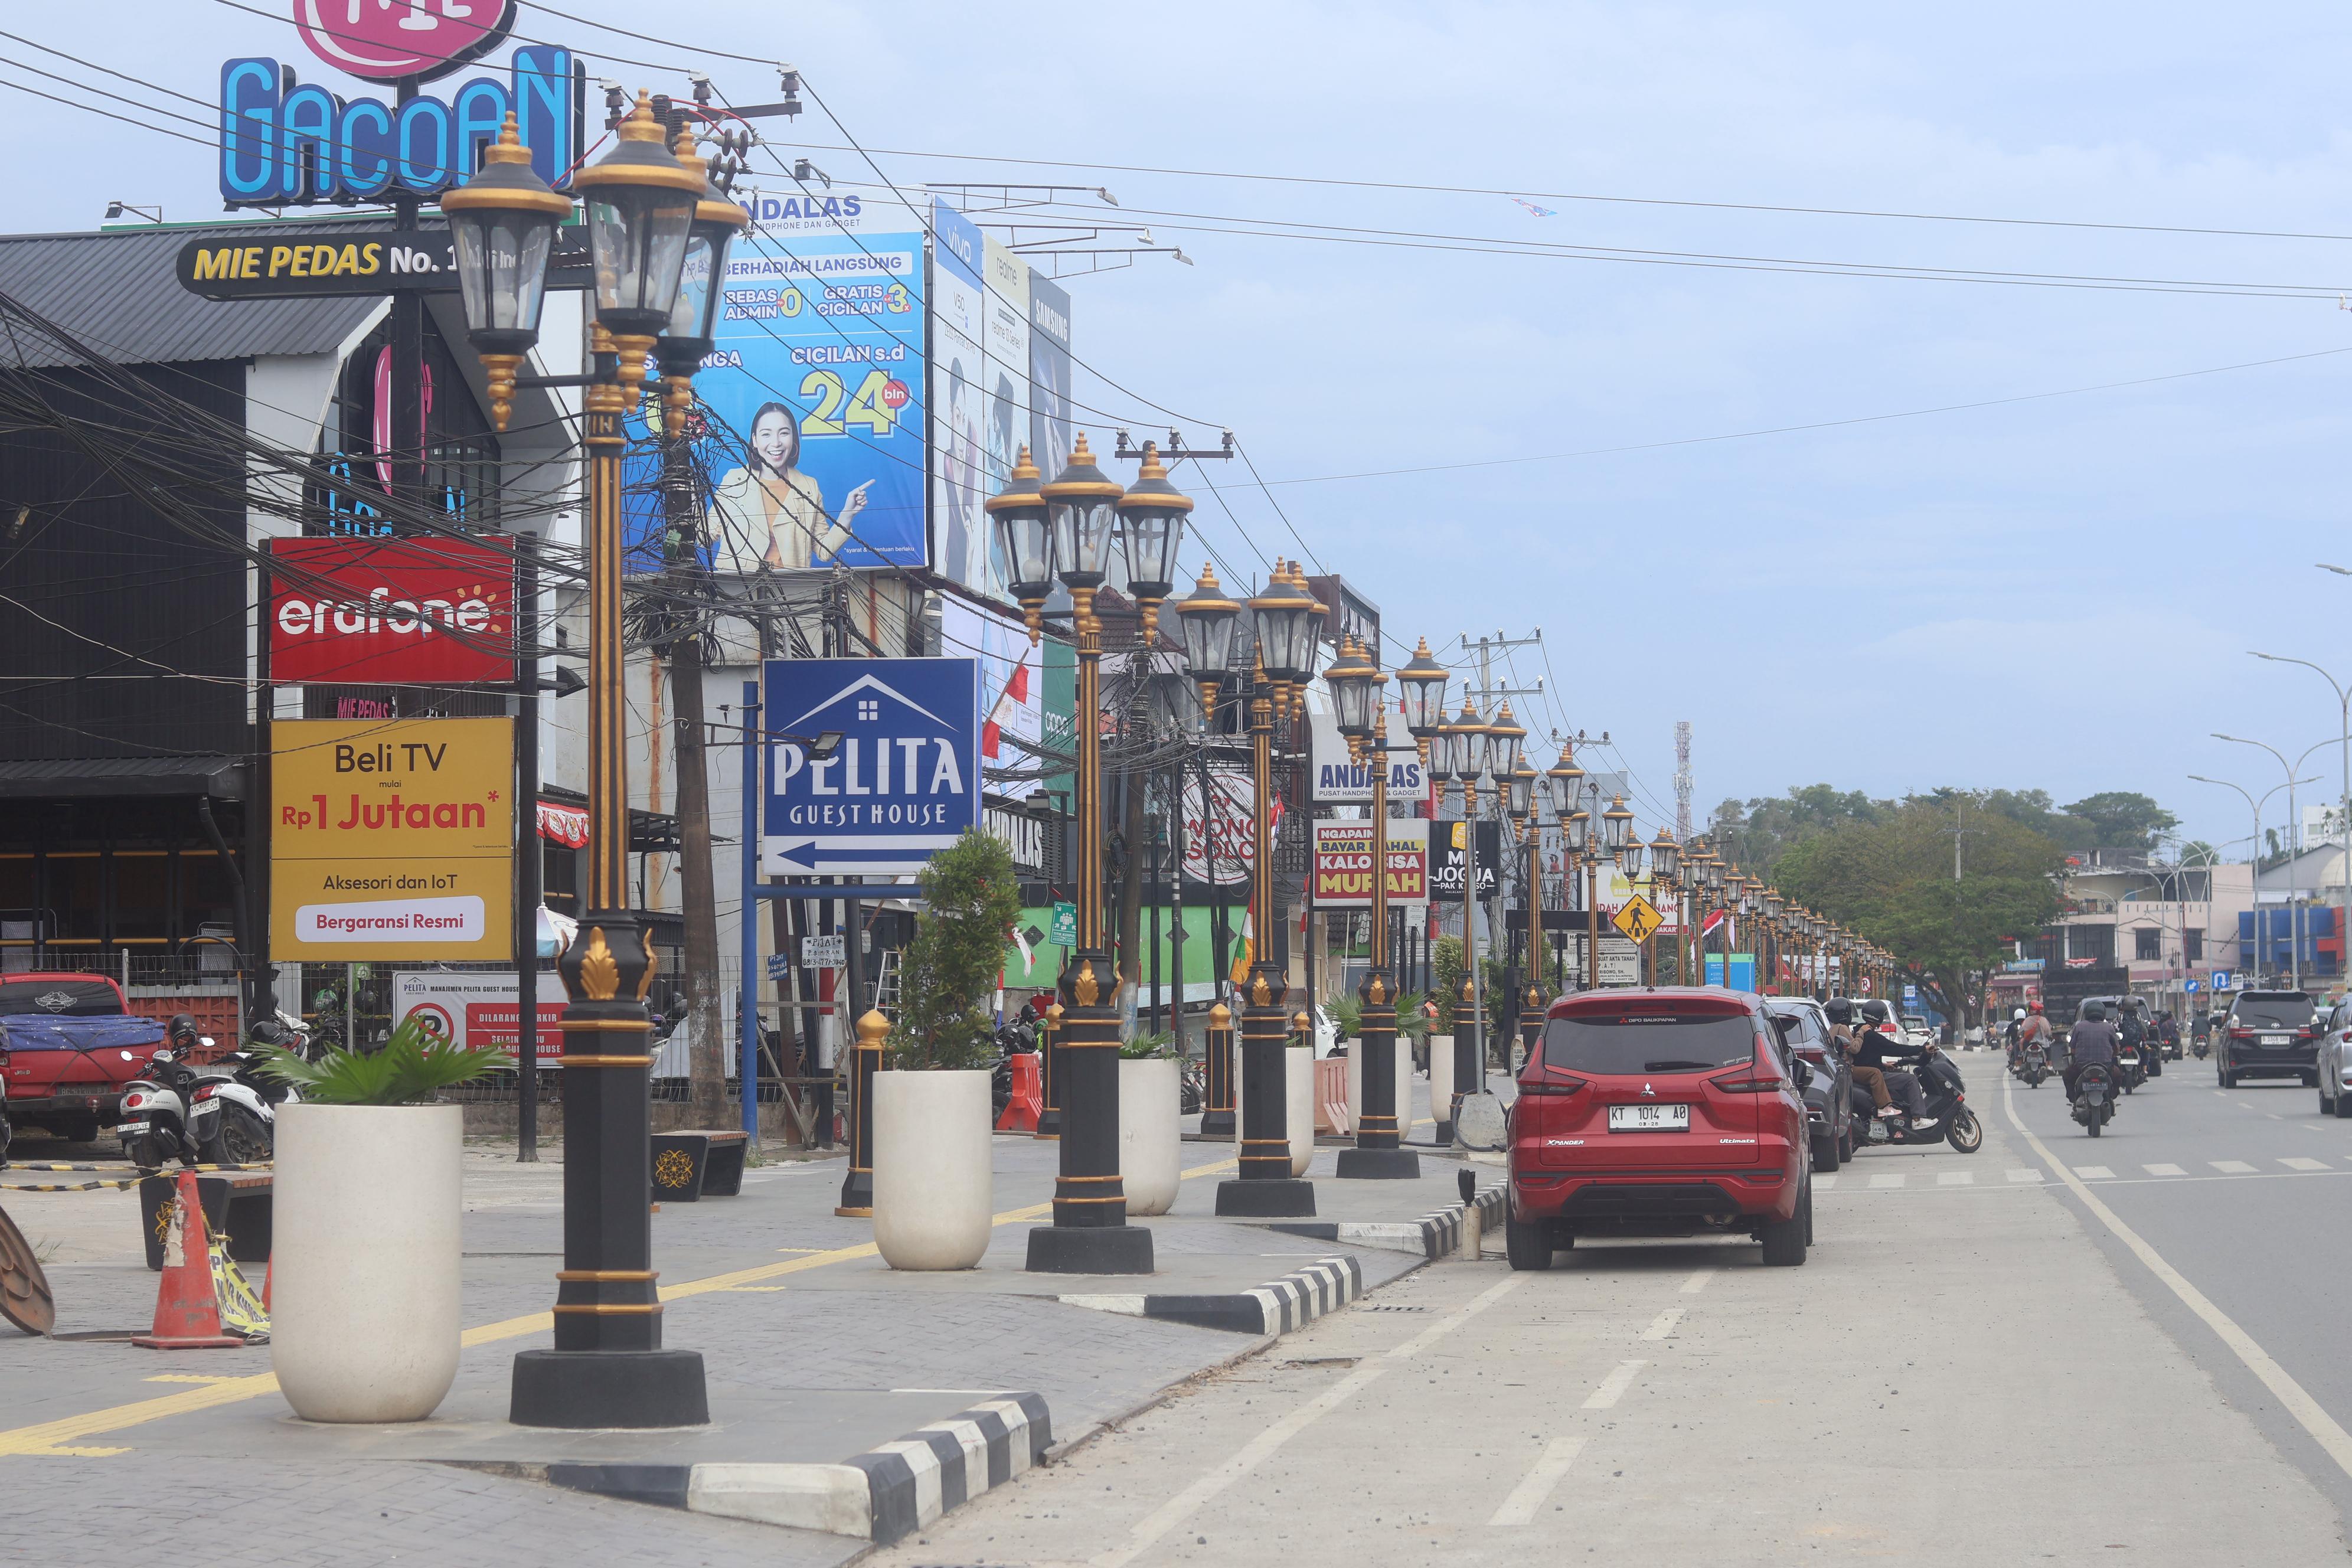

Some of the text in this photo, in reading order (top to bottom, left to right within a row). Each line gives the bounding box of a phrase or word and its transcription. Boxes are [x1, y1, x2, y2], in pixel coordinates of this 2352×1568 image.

[225, 50, 566, 193] GACOAN
[739, 195, 861, 221] NDALAS
[804, 220, 822, 229] DAN
[825, 219, 861, 228] GADGET
[948, 226, 972, 263] vivo
[194, 249, 259, 280] MIE
[268, 242, 383, 278] PEDAS
[390, 247, 439, 275] No.
[726, 260, 811, 275] BERHADIAH
[815, 256, 902, 272] LANGSUNG
[997, 256, 1017, 286] realme
[725, 289, 778, 304] BEBAS
[823, 285, 883, 300] GRATIS
[887, 283, 907, 314] 3
[953, 290, 965, 312] V50
[724, 305, 778, 321] ADMIN
[816, 302, 883, 317] CICILAN
[1036, 298, 1067, 342] SAMSUNG
[700, 349, 743, 367] NGA
[790, 344, 905, 365] CICILAN s.d
[799, 369, 898, 436] 24
[884, 388, 905, 400] bln
[279, 587, 490, 635] erafone
[337, 697, 356, 718] MIE
[358, 700, 388, 718] PEDAS
[1046, 711, 1069, 740] oppo
[335, 743, 447, 773] Beli TV
[772, 737, 963, 796] PELITA
[378, 779, 401, 788] mulai
[1320, 763, 1420, 788] ANDAAS
[789, 803, 945, 827] GUEST HOUSE
[1321, 829, 1374, 839] NGAPAIN
[1187, 841, 1255, 860] SOLO
[1321, 842, 1366, 852] BAYAR
[1320, 855, 1420, 870] KALO ISA
[323, 874, 458, 891] Aksesori dan IoT
[316, 914, 463, 933] Bergaransi Resmi
[404, 984, 426, 992] PELITA
[537, 1014, 557, 1023] RKIR
[1612, 1108, 1625, 1121] KT
[1638, 1107, 1660, 1120] 1014
